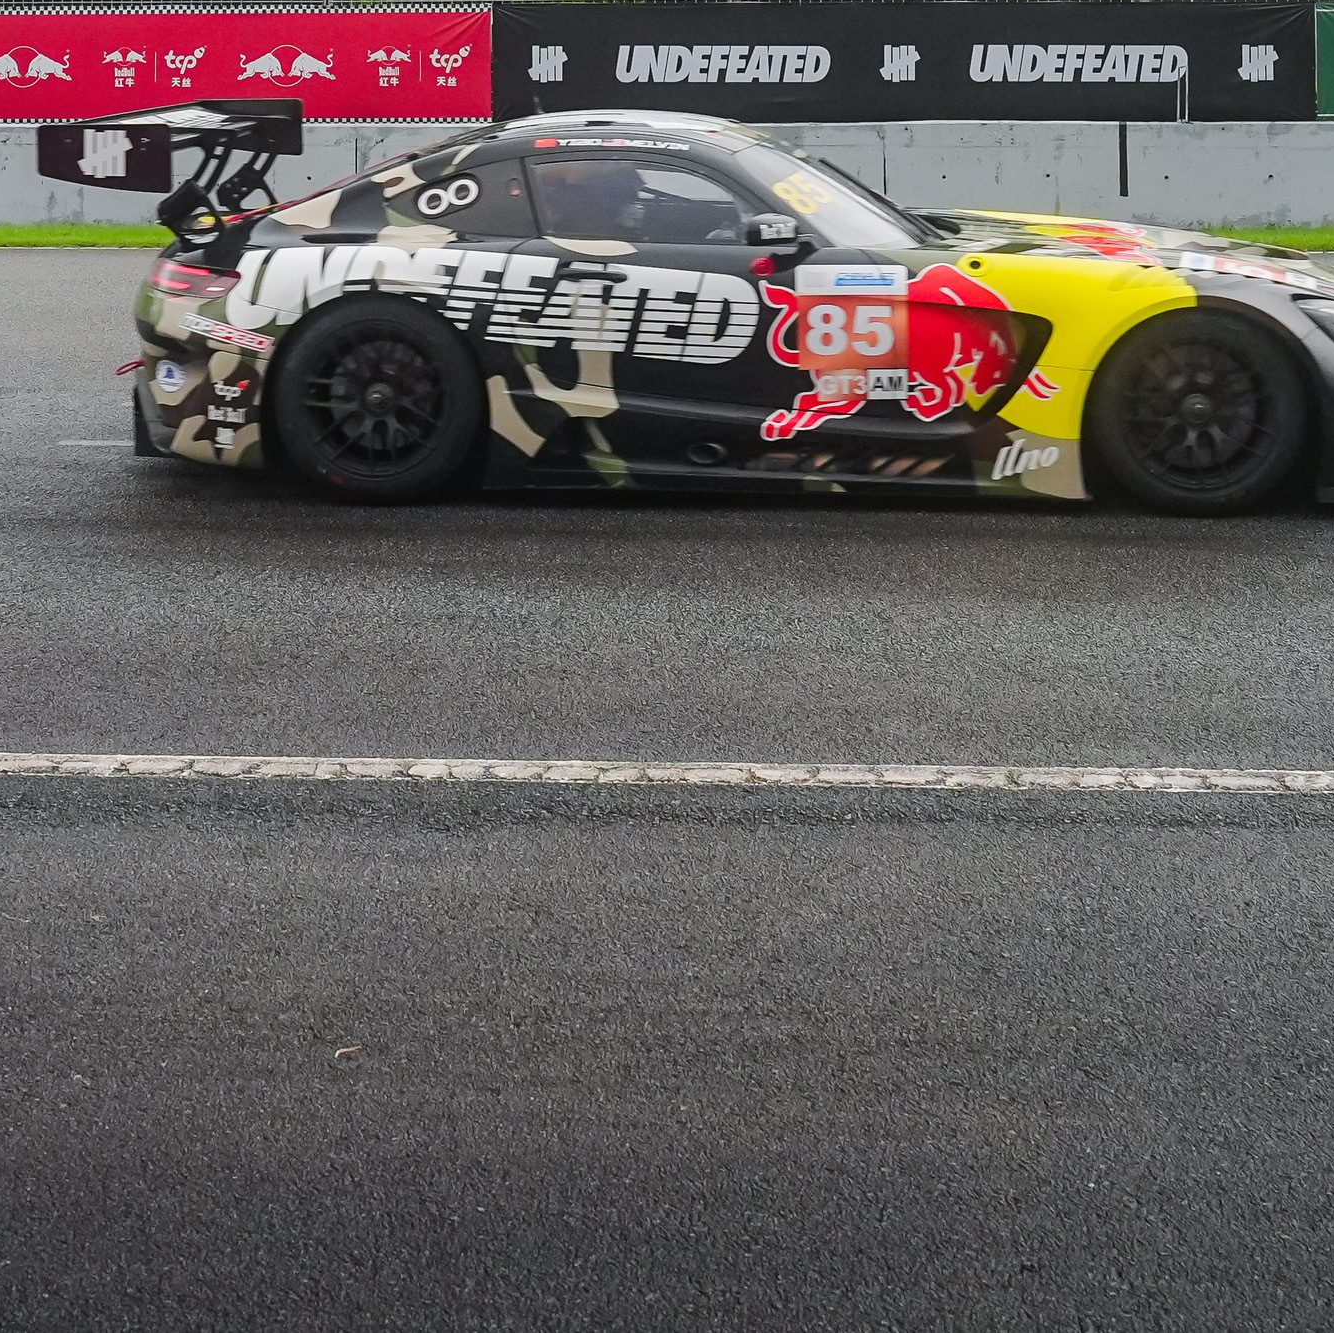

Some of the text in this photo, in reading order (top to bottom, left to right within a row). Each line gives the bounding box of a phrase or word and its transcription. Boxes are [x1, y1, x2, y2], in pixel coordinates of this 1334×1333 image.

[164, 50, 197, 74] tcp
[429, 48, 463, 74] tcp
[615, 45, 830, 83] UNDEFEATED
[969, 44, 1188, 83] UNDEFEATED
[115, 78, 135, 87] 红牛
[171, 78, 191, 87] 天丝
[379, 77, 399, 86] 红牛
[437, 76, 457, 86] 天丝
[773, 174, 833, 215] 85
[805, 304, 895, 356] 85
[818, 374, 903, 395] GT3 AM
